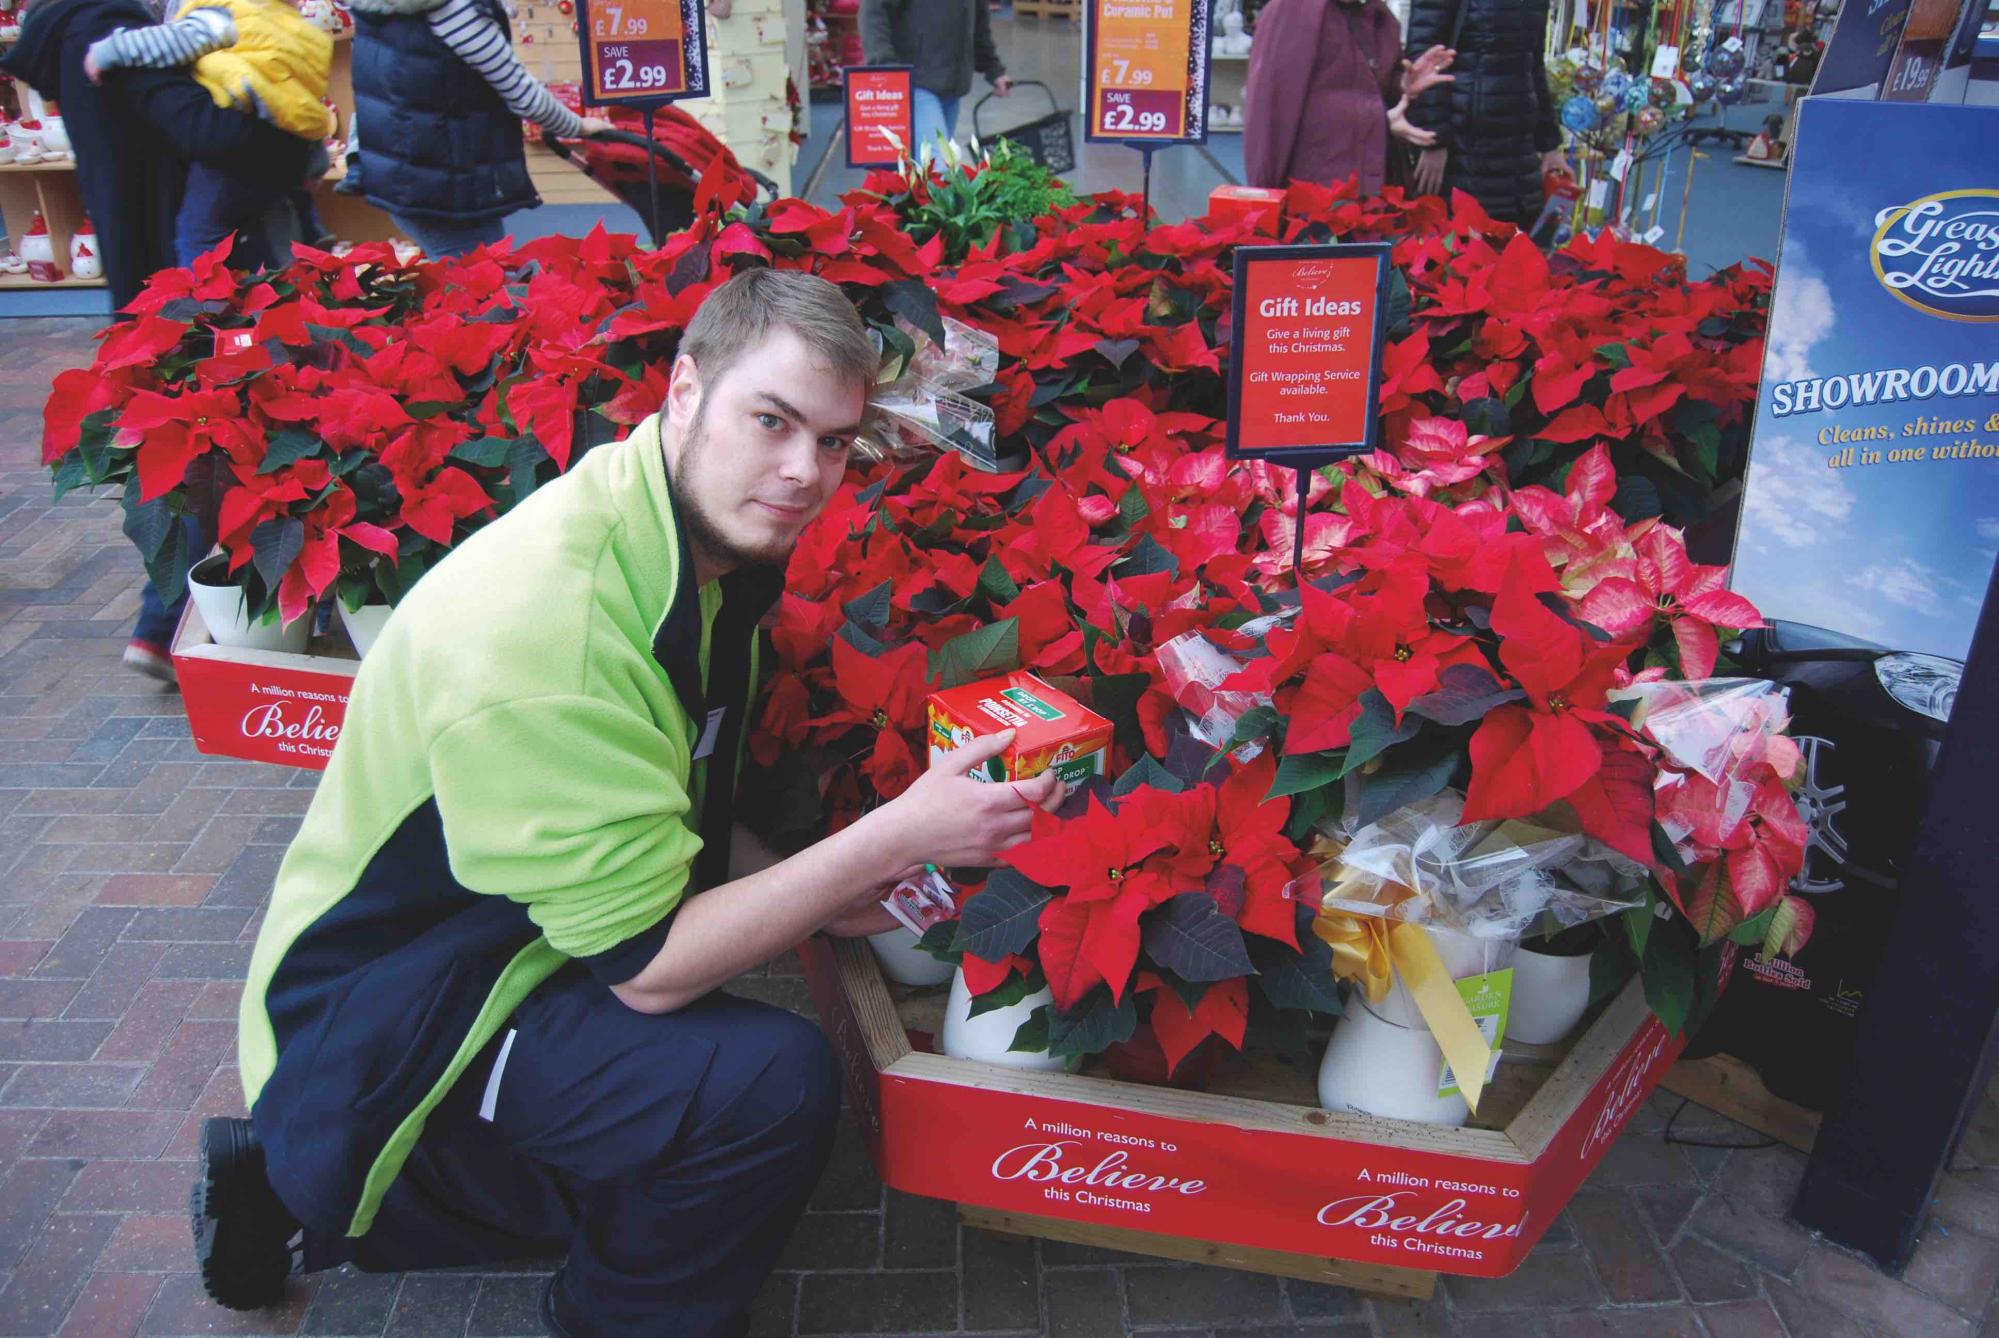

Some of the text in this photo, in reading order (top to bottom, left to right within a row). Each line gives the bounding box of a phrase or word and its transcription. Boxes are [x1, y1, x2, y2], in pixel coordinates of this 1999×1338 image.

[595, 8, 648, 36] £7.99
[1103, 3, 1174, 18] Ceramic Pot
[604, 46, 629, 58] SAVE
[604, 59, 667, 89] £2.99
[1102, 60, 1153, 85] £7.99
[1106, 92, 1132, 103] SAVE
[1104, 104, 1167, 132] £2.99
[1883, 242, 1999, 298] Light
[1259, 296, 1361, 317] Gift Ideas
[1266, 326, 1351, 341] Give a living gift
[1269, 341, 1346, 354] this Christmas.
[1249, 369, 1360, 384] Gift Wrapping Service
[1279, 384, 1329, 397] available.
[1772, 362, 1999, 418] SHOWROOM
[1274, 412, 1330, 424] Thank You.
[1818, 424, 1895, 446] Cleans,
[1903, 416, 1975, 438] shines
[1827, 440, 1999, 470] all in one witho
[250, 682, 350, 704] A million reasons to
[241, 700, 344, 741] Belie
[278, 741, 297, 753] this
[1056, 750, 1076, 763] FITO
[1063, 767, 1086, 781] DROP
[1024, 1117, 1177, 1152] A million reasons to
[991, 1140, 1207, 1194] Believe
[1357, 1167, 1520, 1198] A million reasons to
[1043, 1187, 1151, 1213] this Christmas
[1370, 1233, 1483, 1261] this Christmas
